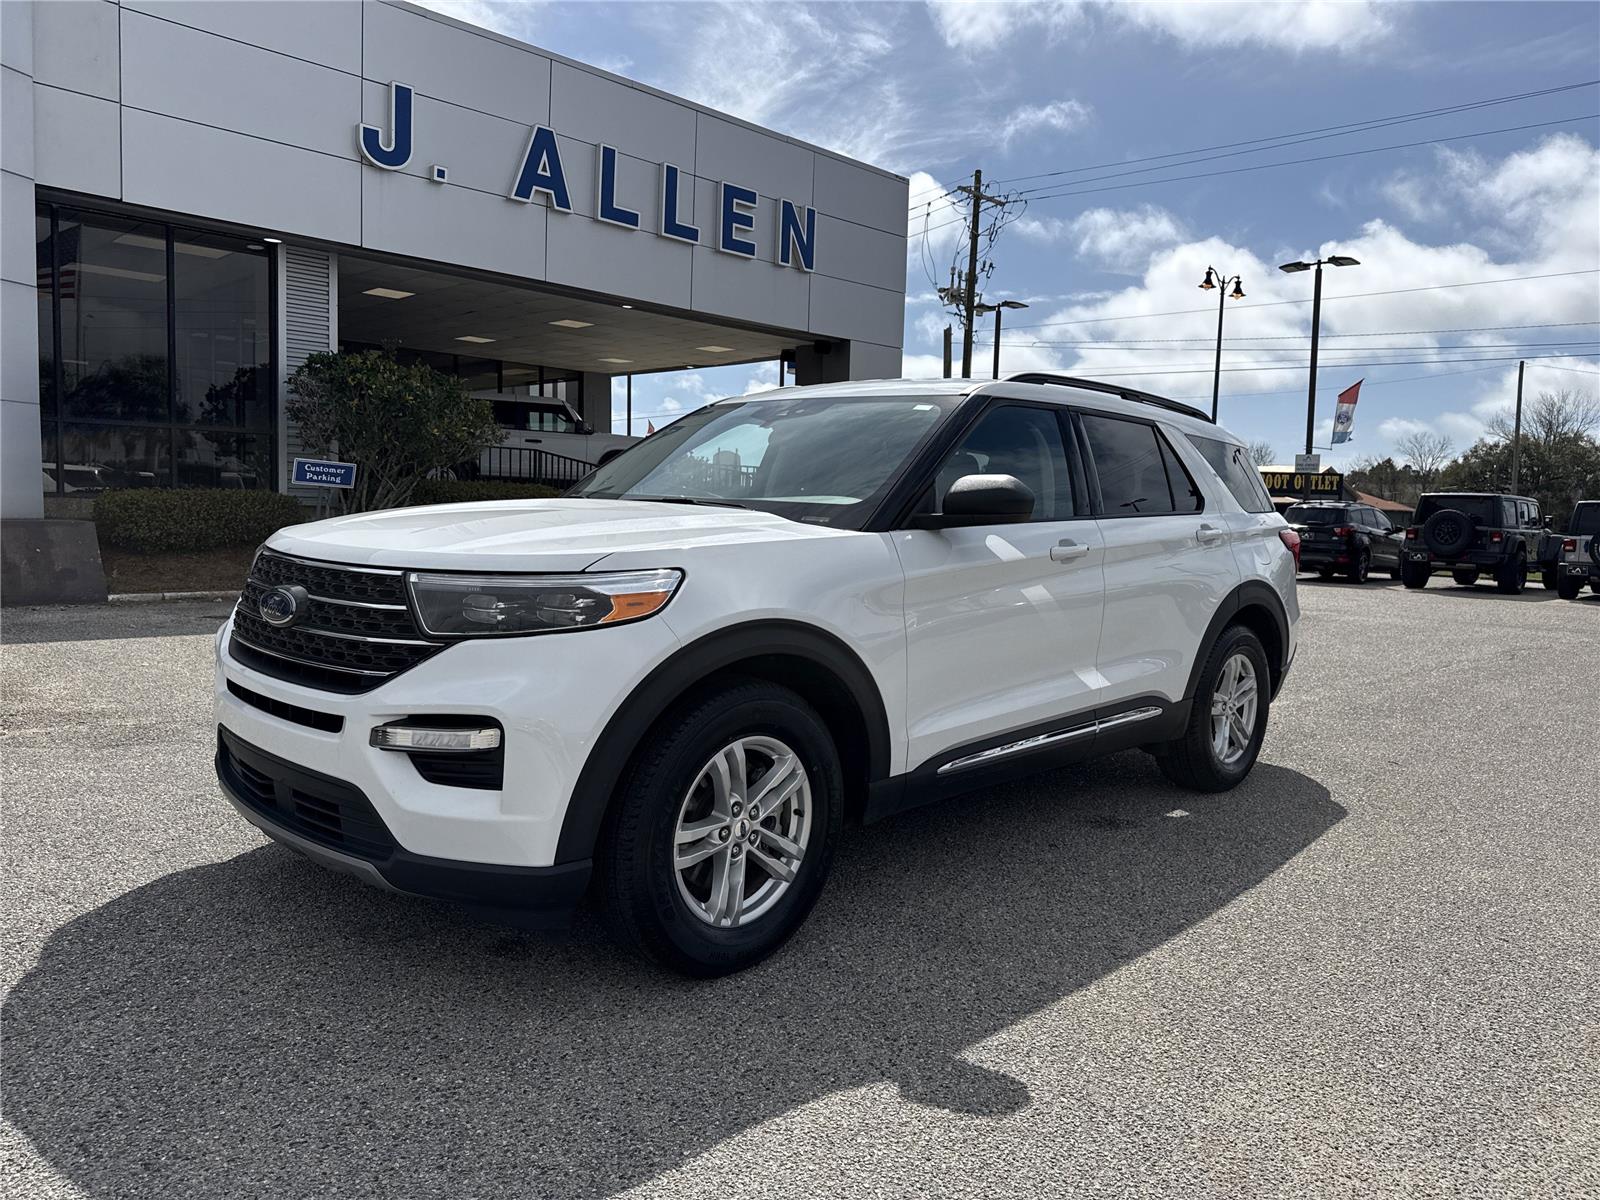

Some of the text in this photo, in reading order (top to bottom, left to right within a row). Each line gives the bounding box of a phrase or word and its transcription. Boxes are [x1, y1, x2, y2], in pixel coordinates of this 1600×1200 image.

[356, 80, 818, 272] J. ALLEN
[304, 463, 346, 474] Customer
[306, 472, 341, 483] Parking
[1263, 473, 1340, 490] OOT OTLET
